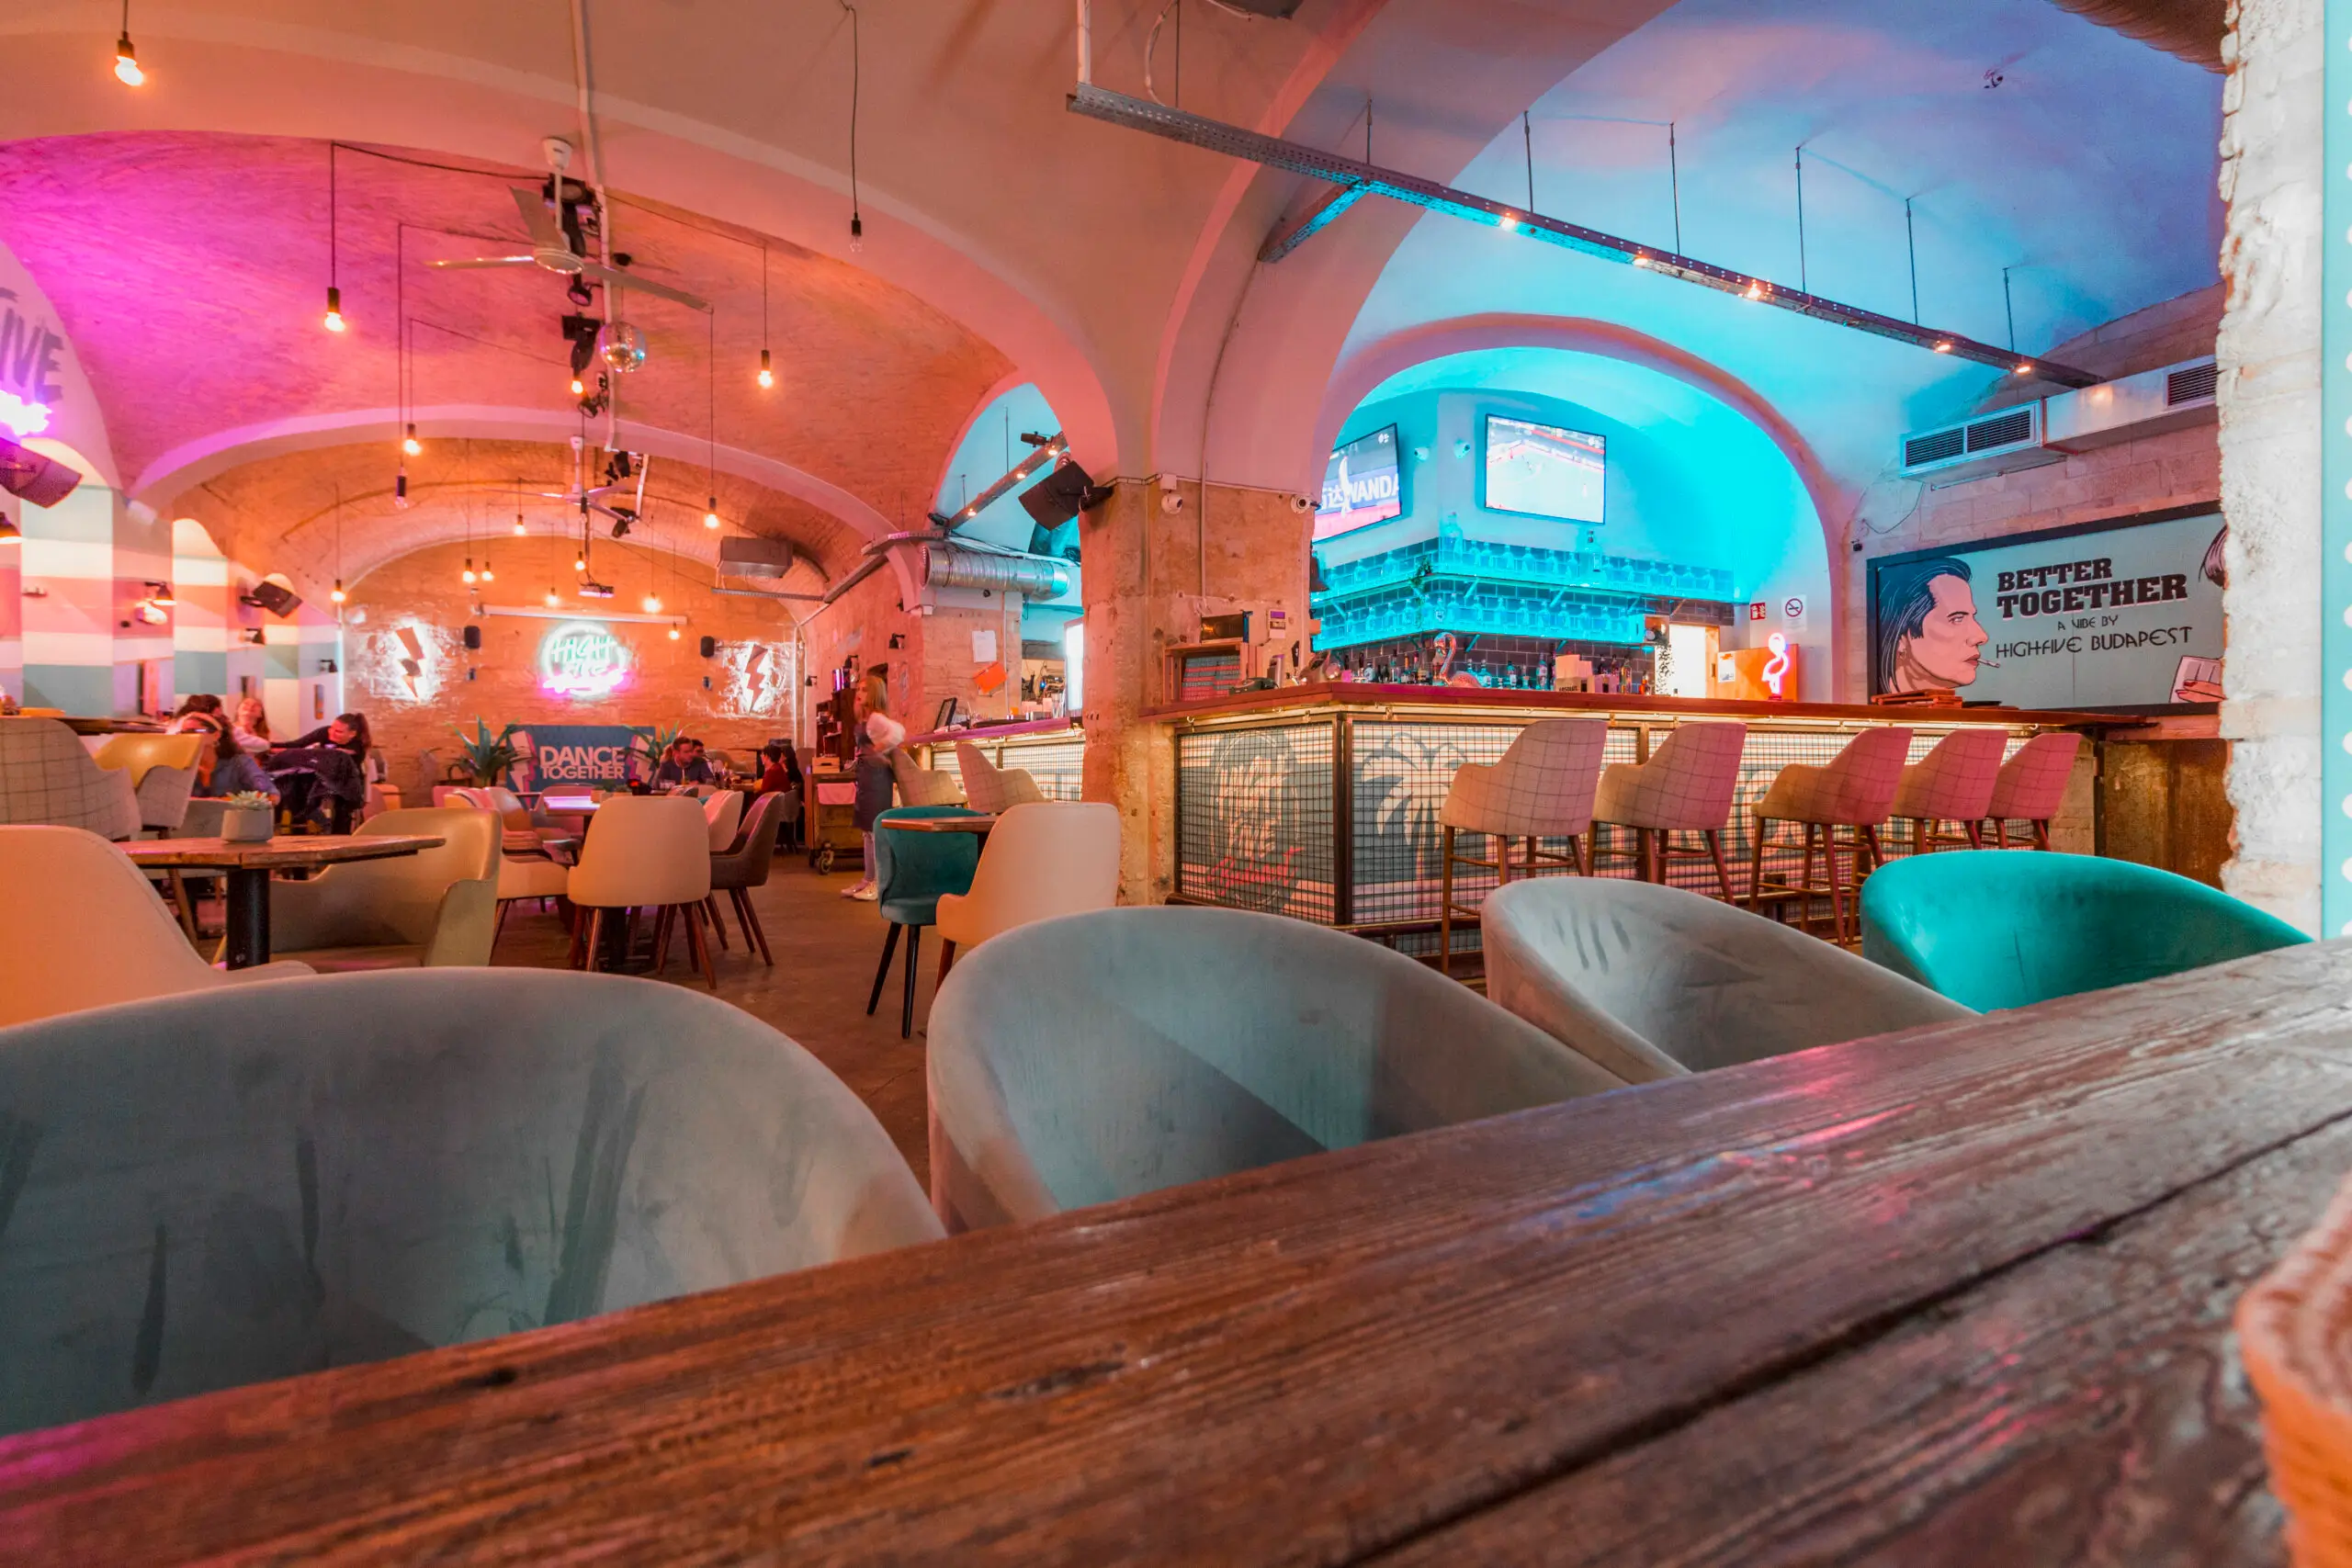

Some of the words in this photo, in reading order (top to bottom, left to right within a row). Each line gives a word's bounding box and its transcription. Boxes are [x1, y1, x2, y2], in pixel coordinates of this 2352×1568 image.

[1997, 558, 2112, 592] BETTER
[1996, 573, 2188, 619] TOGETHER
[2057, 620, 2066, 631] A
[2072, 616, 2096, 629] VIBE
[2101, 615, 2119, 627] BY
[551, 635, 618, 663] HIGH
[1996, 636, 2082, 659] HIGHFIVE
[2091, 626, 2193, 651] BUDAPEST
[539, 745, 625, 766] DANCE
[540, 765, 625, 780] TOGETHER
